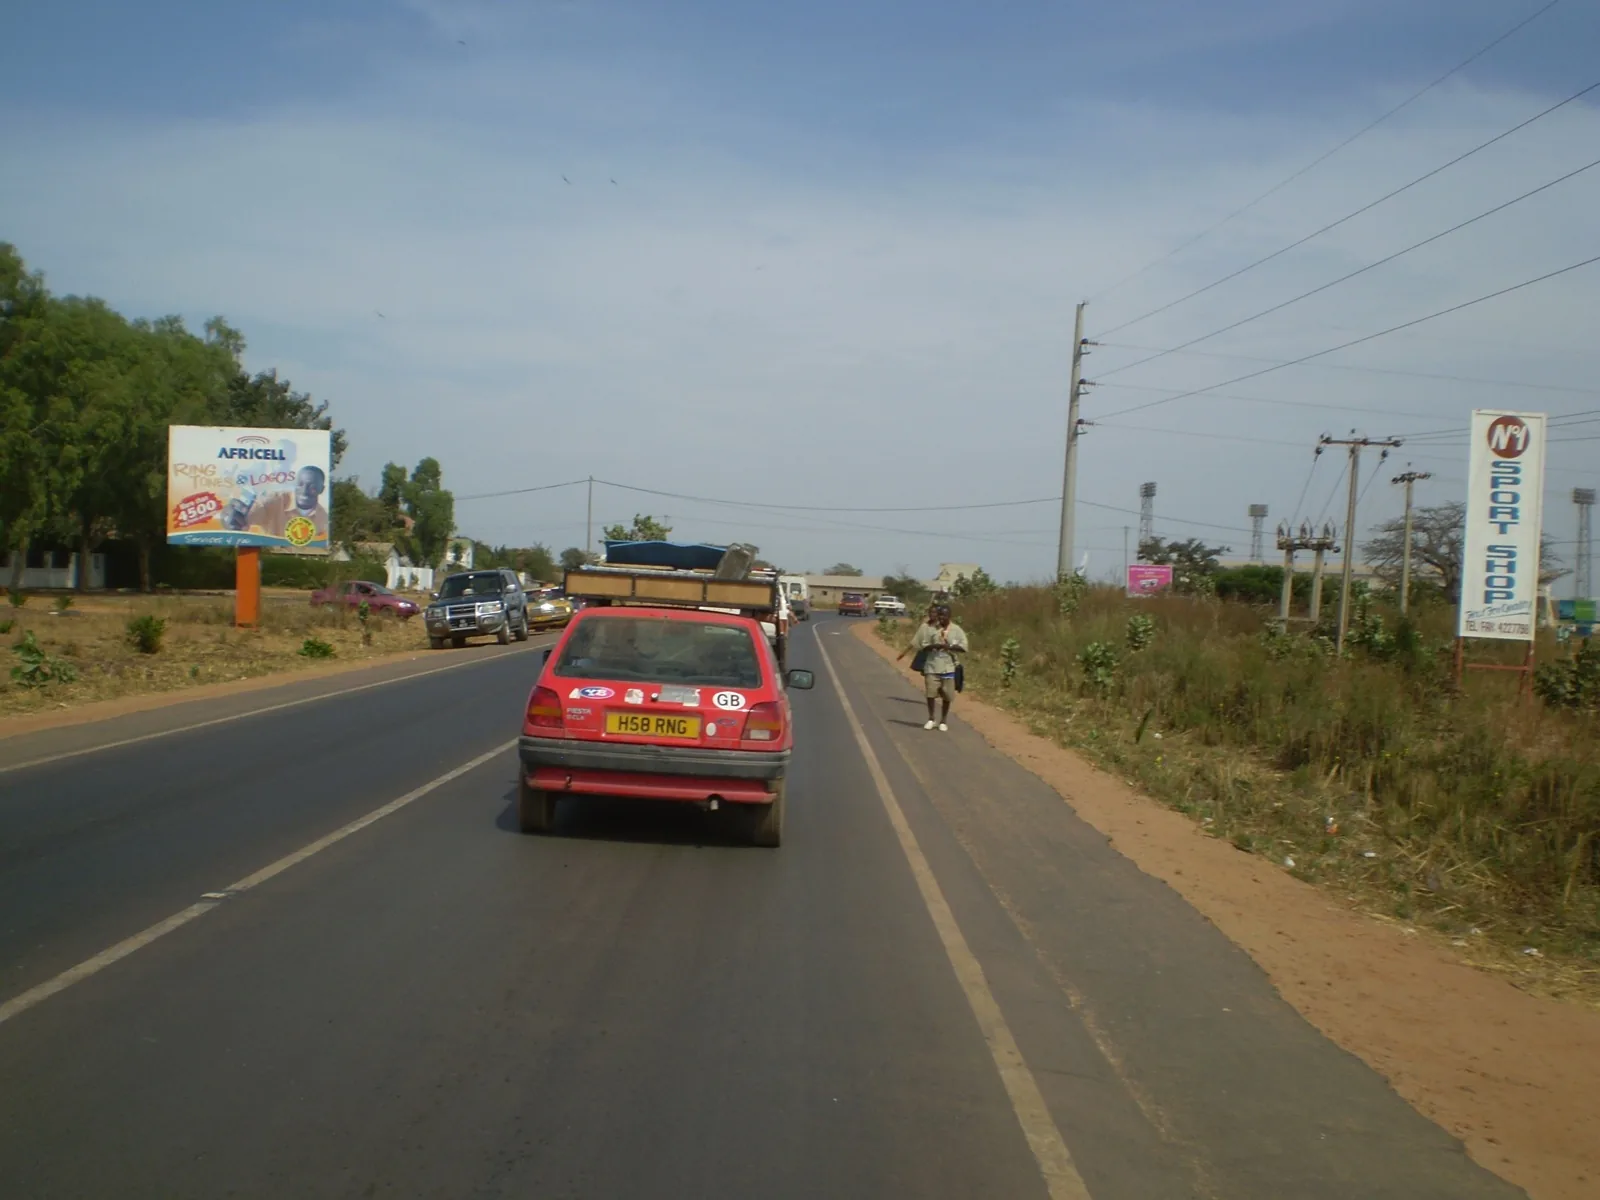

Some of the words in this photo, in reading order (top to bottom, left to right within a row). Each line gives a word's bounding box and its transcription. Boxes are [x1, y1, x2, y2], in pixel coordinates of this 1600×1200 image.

[218, 447, 286, 461] AFRICELL
[173, 463, 217, 477] RING
[190, 475, 235, 489] TONES
[236, 474, 249, 486] &
[250, 471, 296, 487] LOGOS
[1488, 460, 1522, 535] SPORT
[177, 499, 217, 522] 4500
[1483, 544, 1518, 605] SHOP
[717, 693, 740, 707] GB
[618, 716, 651, 732] H58
[655, 718, 687, 735] RNG
